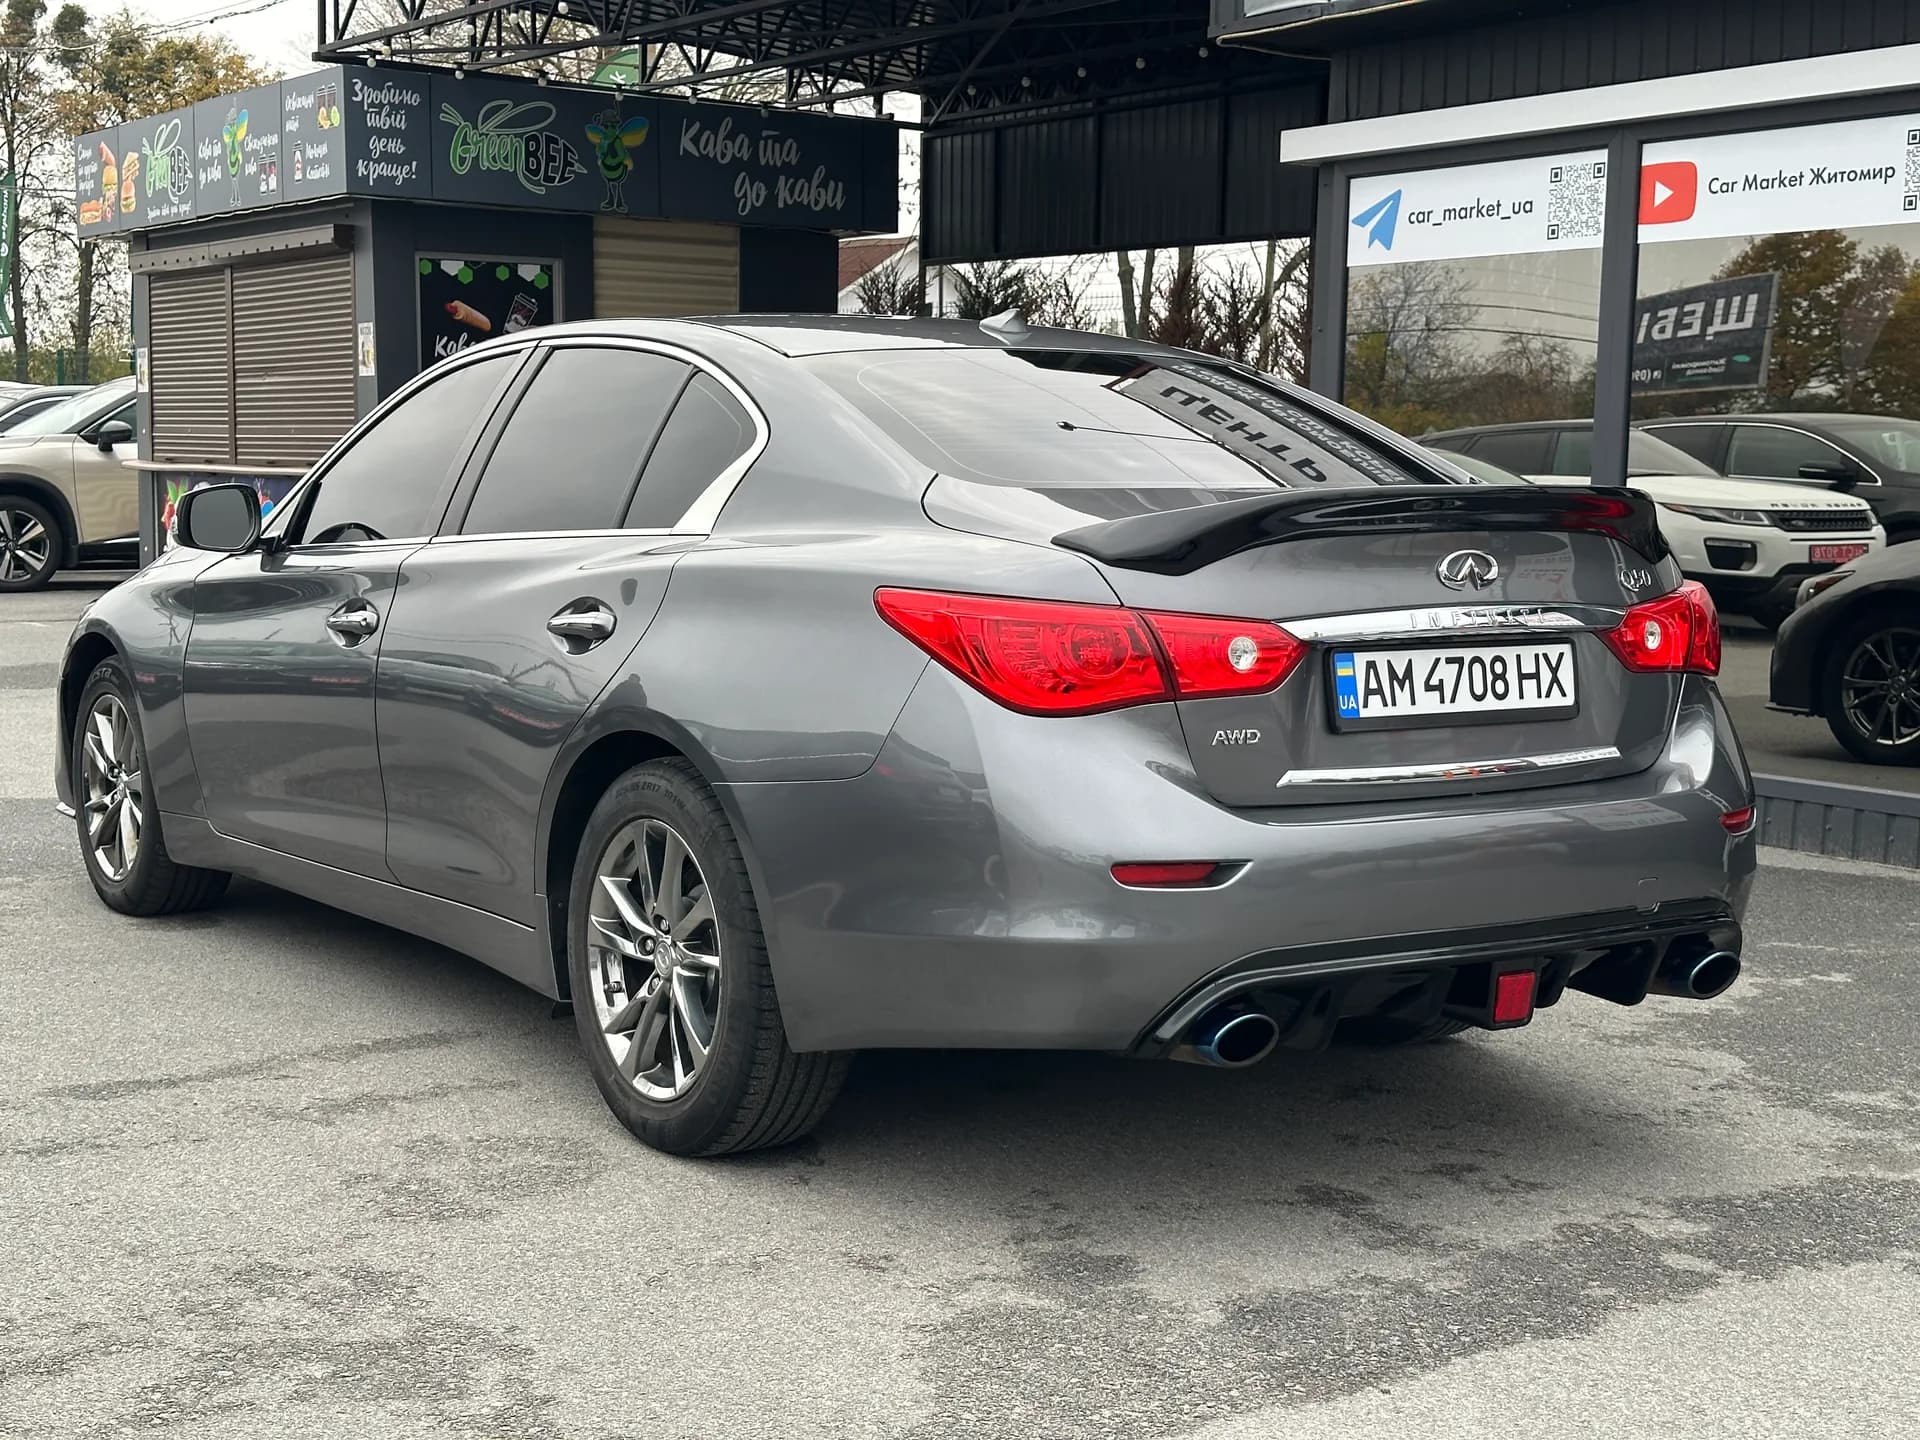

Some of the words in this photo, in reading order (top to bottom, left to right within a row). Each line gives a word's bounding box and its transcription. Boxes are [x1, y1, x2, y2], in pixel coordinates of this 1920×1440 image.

[352, 79, 421, 110] Зробимо
[367, 105, 407, 130] твій
[369, 135, 406, 159] день
[680, 116, 752, 165] Кава
[758, 129, 800, 168] та
[356, 158, 418, 186] краще!
[1708, 177, 1738, 194] Car
[1742, 169, 1805, 192] Market
[1808, 165, 1896, 186] Житомир
[734, 171, 769, 216] до
[775, 164, 847, 212] кави
[1408, 197, 1533, 226] car_market_ua
[434, 331, 477, 358] Кав
[1620, 568, 1651, 592] Q50
[1409, 606, 1544, 629] INFINITI
[1362, 657, 1416, 708] AM
[1424, 654, 1509, 704] 4708
[1516, 651, 1567, 700] HX
[1339, 695, 1357, 710] UA
[1211, 729, 1261, 746] AWD
